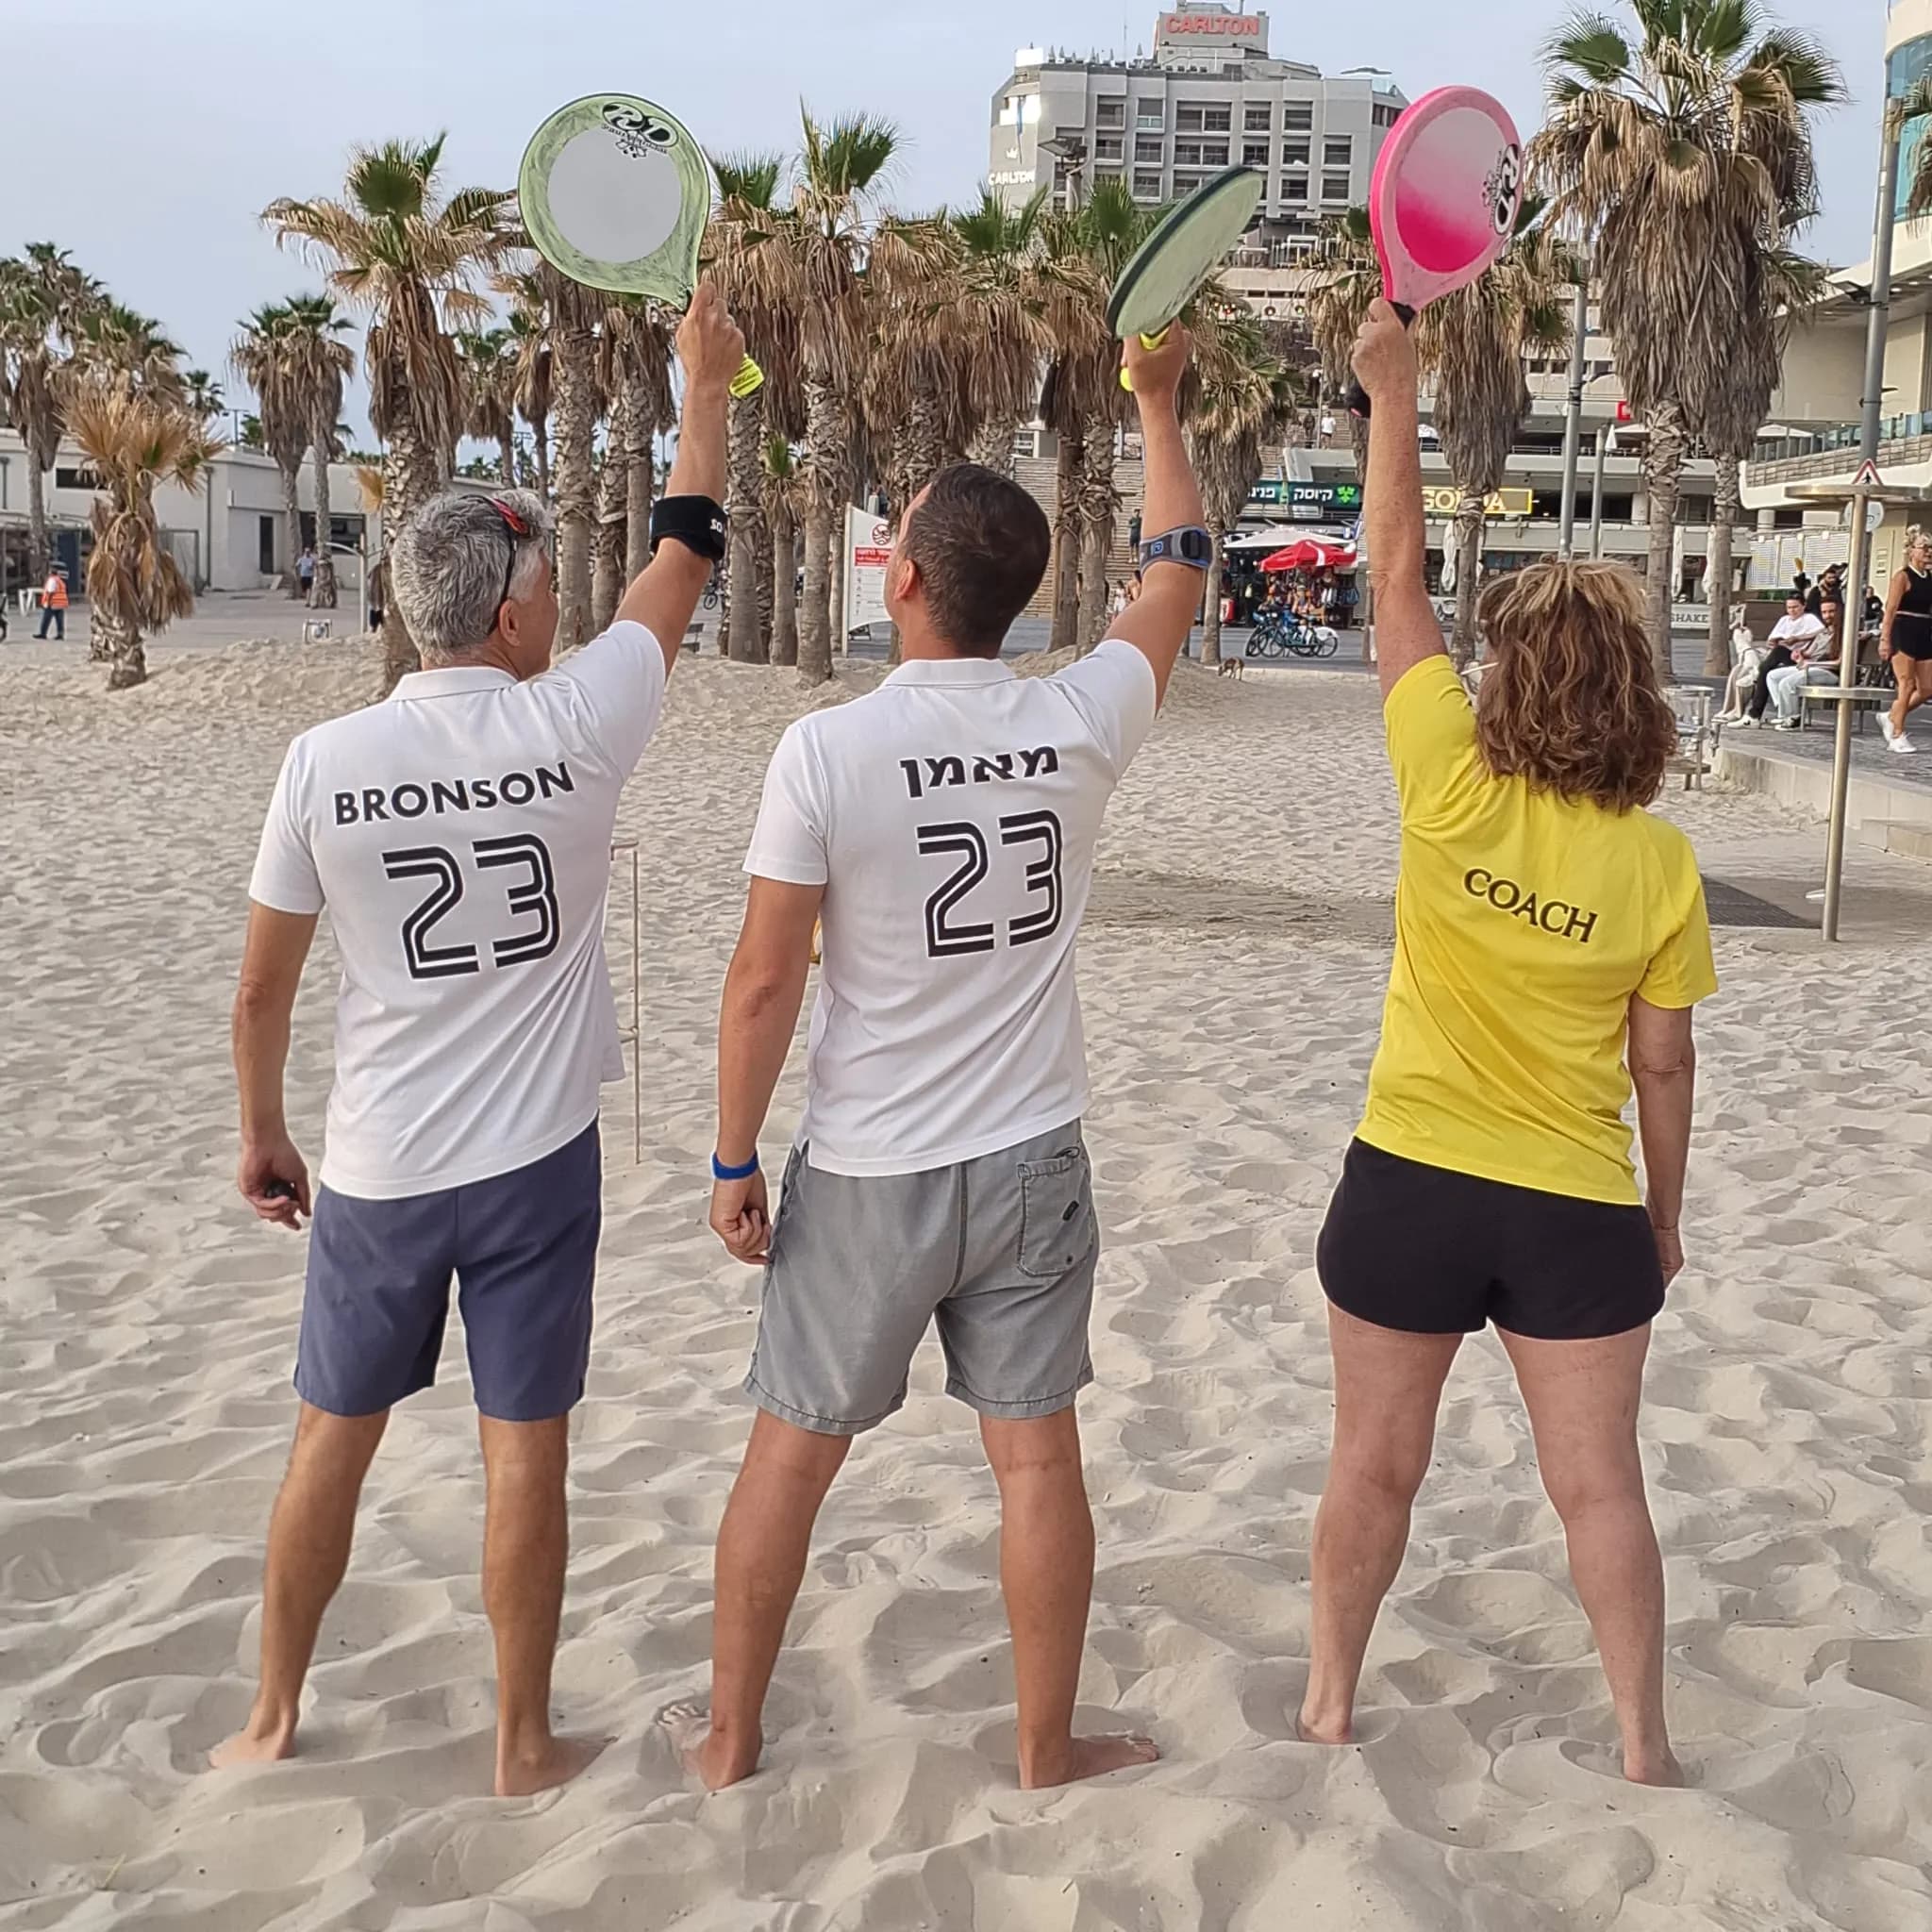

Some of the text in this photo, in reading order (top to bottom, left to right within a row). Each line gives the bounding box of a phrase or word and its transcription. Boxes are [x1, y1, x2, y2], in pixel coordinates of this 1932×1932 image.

[1166, 16, 1260, 36] CARLTON
[989, 171, 1036, 186] CARLTON
[1293, 488, 1333, 502] קיוסק
[1422, 490, 1507, 511] GOA
[334, 761, 575, 825] BRONSON
[899, 745, 1059, 798] מאמן
[381, 833, 561, 979] 23
[916, 808, 1063, 958] 23
[1463, 868, 1598, 943] COACH
